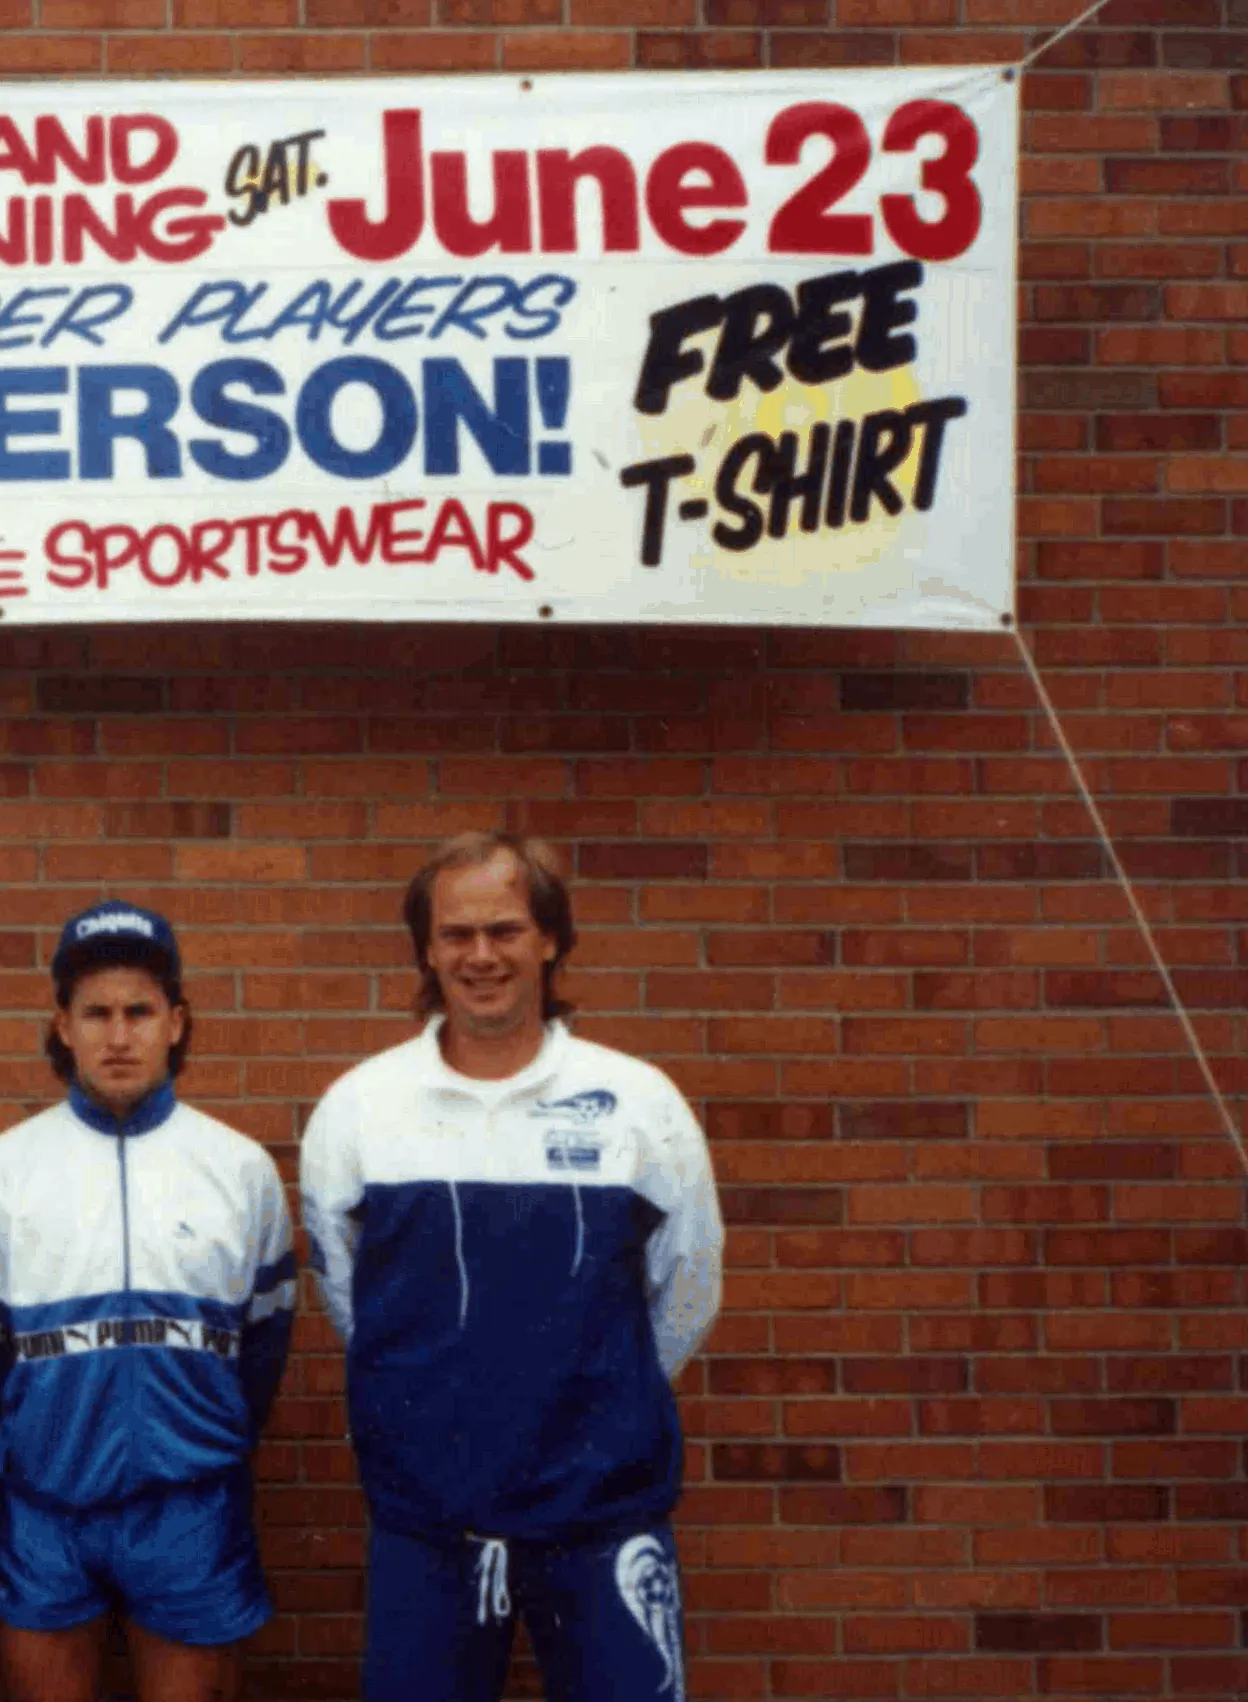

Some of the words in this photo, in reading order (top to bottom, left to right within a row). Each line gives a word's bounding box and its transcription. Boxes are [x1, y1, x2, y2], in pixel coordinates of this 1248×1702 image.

[223, 129, 328, 226] SAT.
[326, 108, 749, 261] June
[763, 99, 981, 261] 23
[158, 273, 576, 345] PLAYERS
[633, 260, 924, 415] FREE
[45, 498, 534, 589] SPORTSWEAR
[620, 396, 967, 567] T-SHIRT
